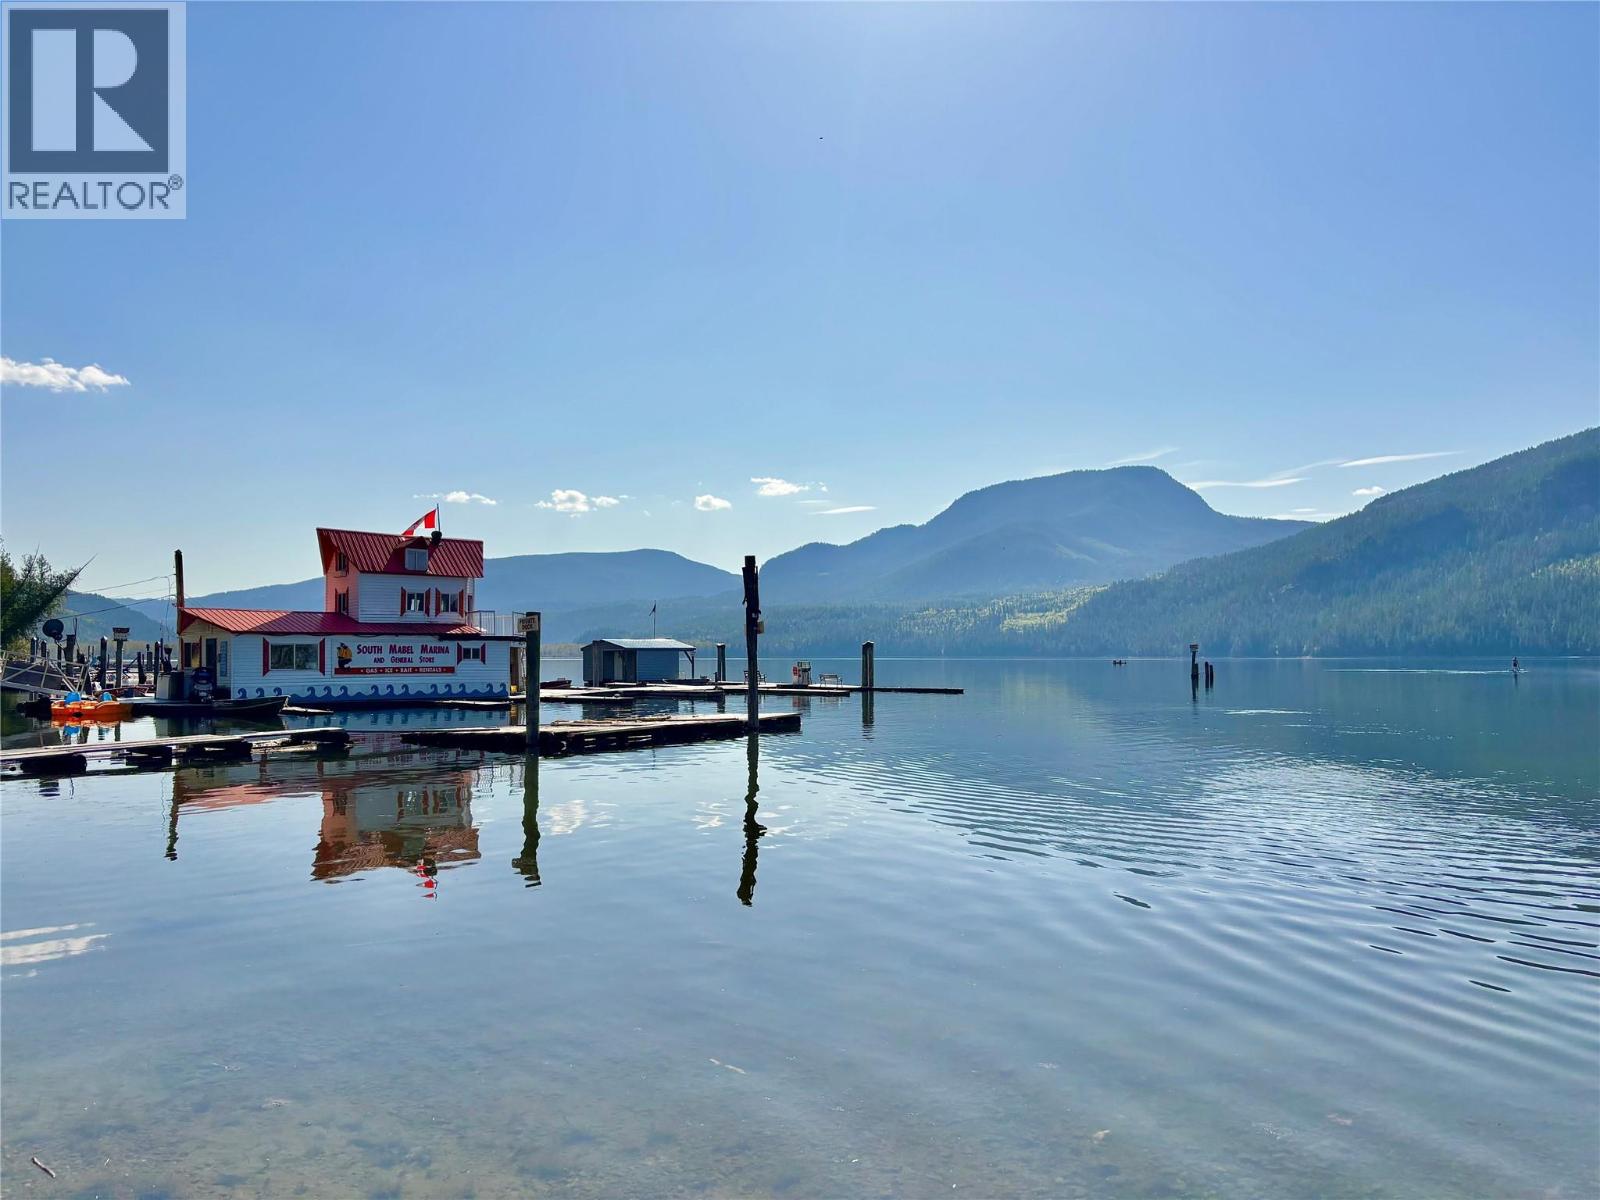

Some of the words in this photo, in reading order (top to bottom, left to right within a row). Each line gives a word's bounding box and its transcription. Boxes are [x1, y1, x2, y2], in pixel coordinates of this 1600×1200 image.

[356, 644, 383, 654] SOUTH
[389, 644, 414, 654] MABEL
[420, 644, 450, 654] MARINA
